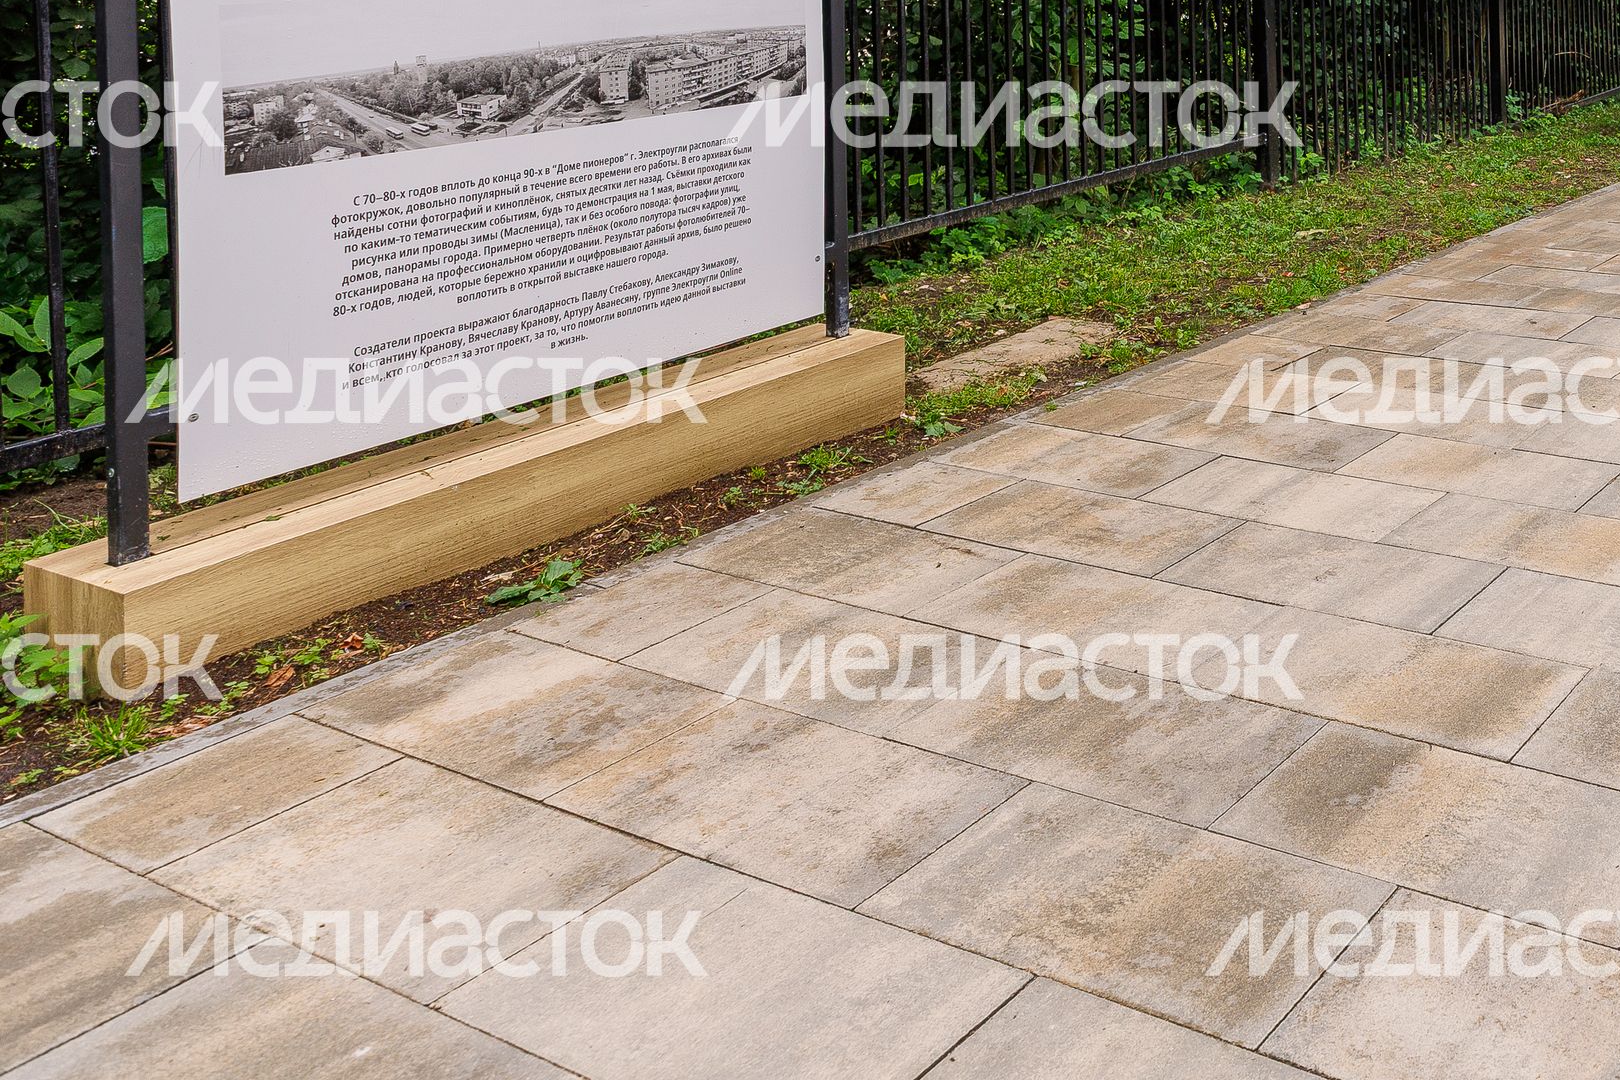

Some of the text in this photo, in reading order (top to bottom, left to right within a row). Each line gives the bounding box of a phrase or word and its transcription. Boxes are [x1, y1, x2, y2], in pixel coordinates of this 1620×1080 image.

[331, 146, 752, 228] фотокружок, довольно популярный в течение всего времени его работы. В его архивах были
[334, 158, 751, 240] найдены сотни фотографий и киноплёнок, снятых десятки лет назад. Съёмки проходили как
[344, 171, 744, 254] по каким-то тематическим событиям, будь то демонстрация на 1 мая, выставки детского
[353, 195, 360, 206] С
[408, 185, 438, 198] годов
[441, 180, 476, 192] вплоть
[477, 177, 490, 188] до
[492, 172, 521, 184] конца
[523, 168, 543, 179] 90-х
[545, 167, 550, 175] в
[630, 153, 637, 161] г.
[638, 145, 688, 159] Электроугли
[689, 135, 738, 153] располагался
[332, 217, 752, 317] 80-х годов, людей, которые бережно хранили и оцифровывают данный архив, было решено
[335, 276, 418, 301] отсканирована
[421, 273, 434, 283] на
[436, 252, 533, 281] профессиональном
[535, 238, 602, 258] оборудовании.
[604, 228, 644, 244] Результат
[646, 222, 675, 237] работы
[676, 207, 736, 230] фотолюбителей
[341, 195, 746, 287] домов, панорамы города. Примерно четверть плёнок (около полутора тысяч кадров) уже
[351, 184, 740, 270] рисунка или проводы зимы (Масленица), так и без особого повода: фотографии улиц,
[353, 256, 739, 357] Создатели проекта выражают благодарность Павлу Стебакову, Александру Зимакову,
[457, 249, 668, 304] воплотить в открытой выставке нашего города.
[342, 382, 348, 390] и
[406, 353, 459, 373] голосовал
[461, 349, 472, 359] за
[474, 344, 495, 356] этот
[496, 334, 532, 351] проект,
[534, 331, 544, 340] за
[546, 328, 559, 337] то,
[561, 322, 576, 332] что
[578, 312, 615, 329] помогли
[616, 301, 659, 318] воплотить
[660, 295, 682, 307] идею
[682, 285, 711, 303] данной
[712, 278, 746, 293] выставки
[348, 267, 743, 374] Константину Кранову, Вячеславу Кранову, Артуру Аванесяну, группе Электроугли Online
[550, 334, 588, 349] в жизнь.
